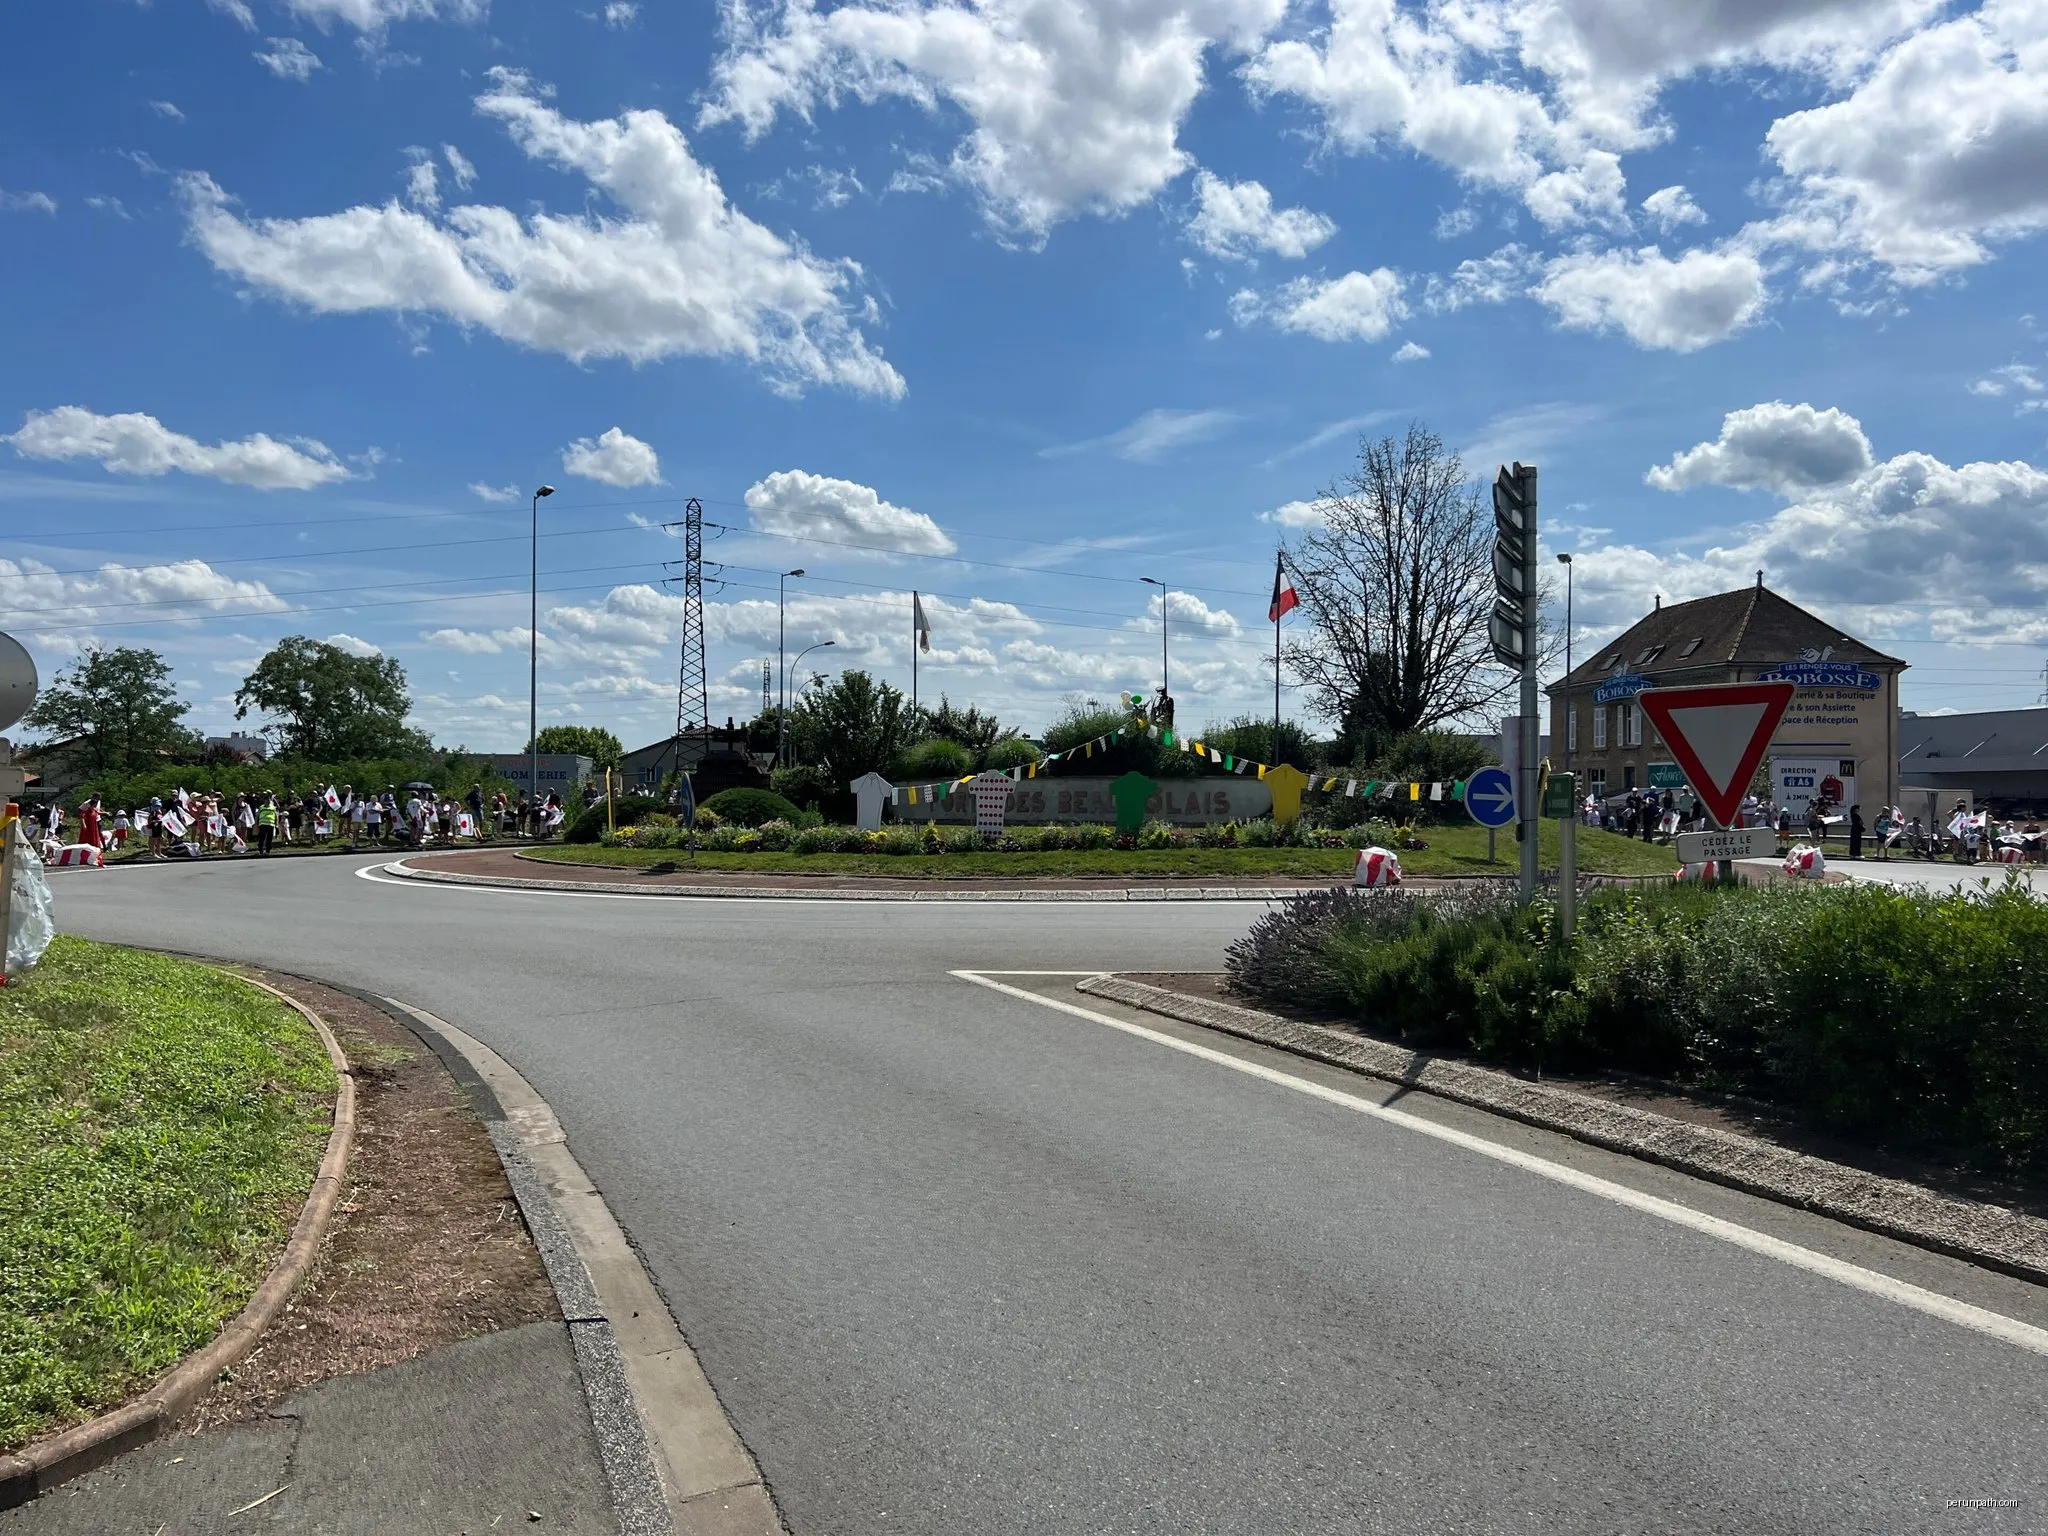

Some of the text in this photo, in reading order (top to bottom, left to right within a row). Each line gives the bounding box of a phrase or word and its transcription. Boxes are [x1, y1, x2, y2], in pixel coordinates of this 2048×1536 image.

[1785, 663, 1852, 671] LES RENDEZ-VOUS
[1836, 691, 1876, 701] Boutique
[1803, 716, 1815, 724] de
[1816, 715, 1859, 725] Réception
[1702, 835, 1752, 847] CÉDEZ LE
[1704, 846, 1751, 857] PASSAGE
